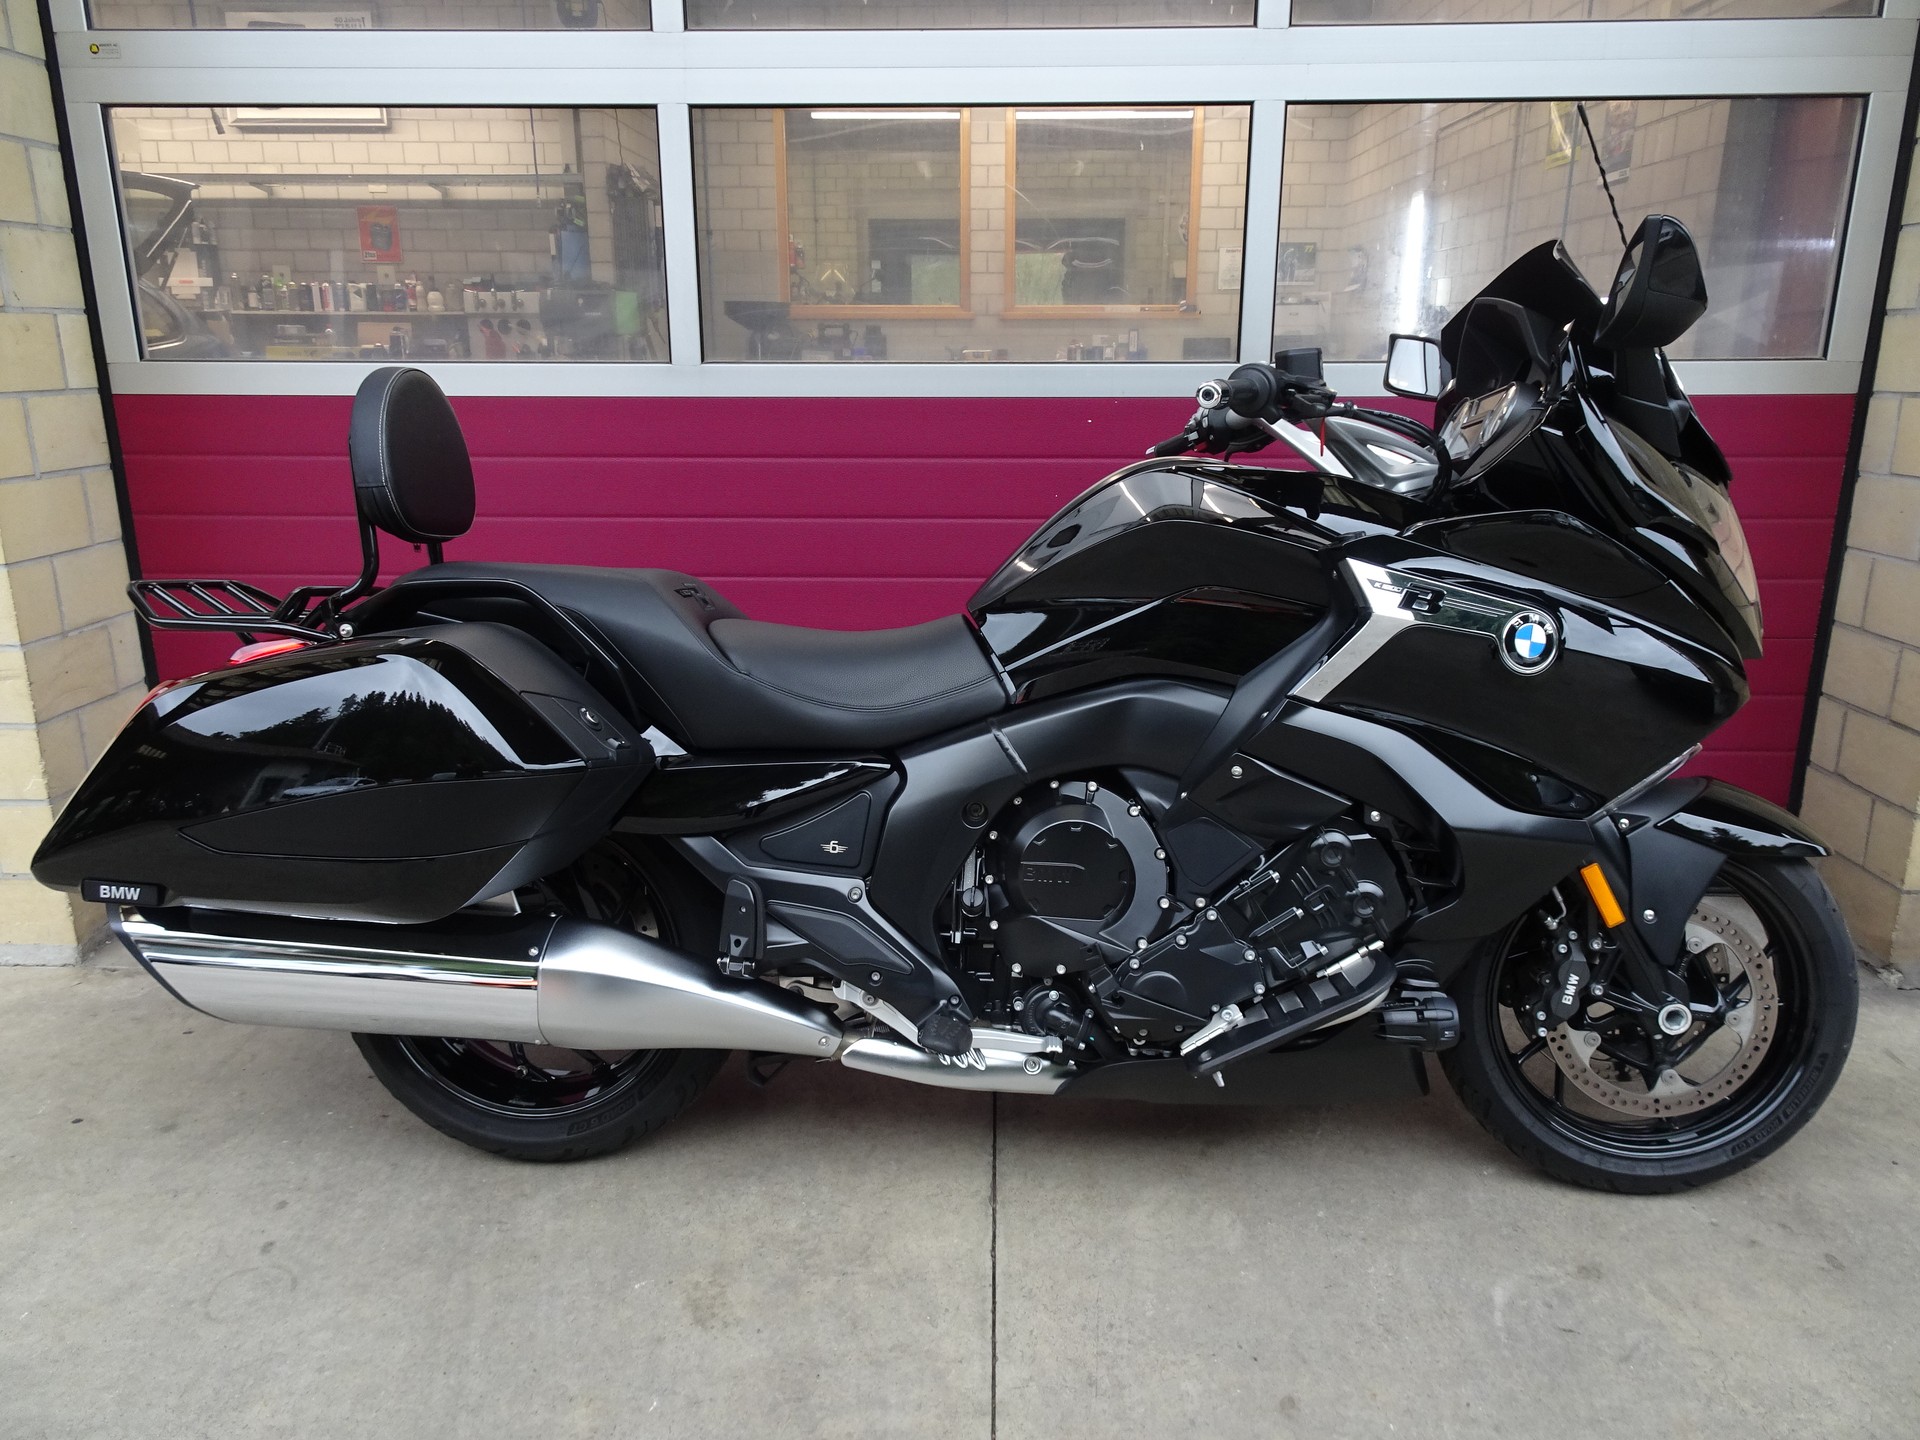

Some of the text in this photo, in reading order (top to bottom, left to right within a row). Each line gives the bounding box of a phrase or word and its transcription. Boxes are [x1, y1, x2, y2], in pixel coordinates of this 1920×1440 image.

[1398, 583, 1447, 614] B
[1511, 613, 1554, 635] BMW
[829, 840, 839, 854] 6
[99, 885, 141, 901] BMW
[1561, 973, 1580, 1005] BMW
